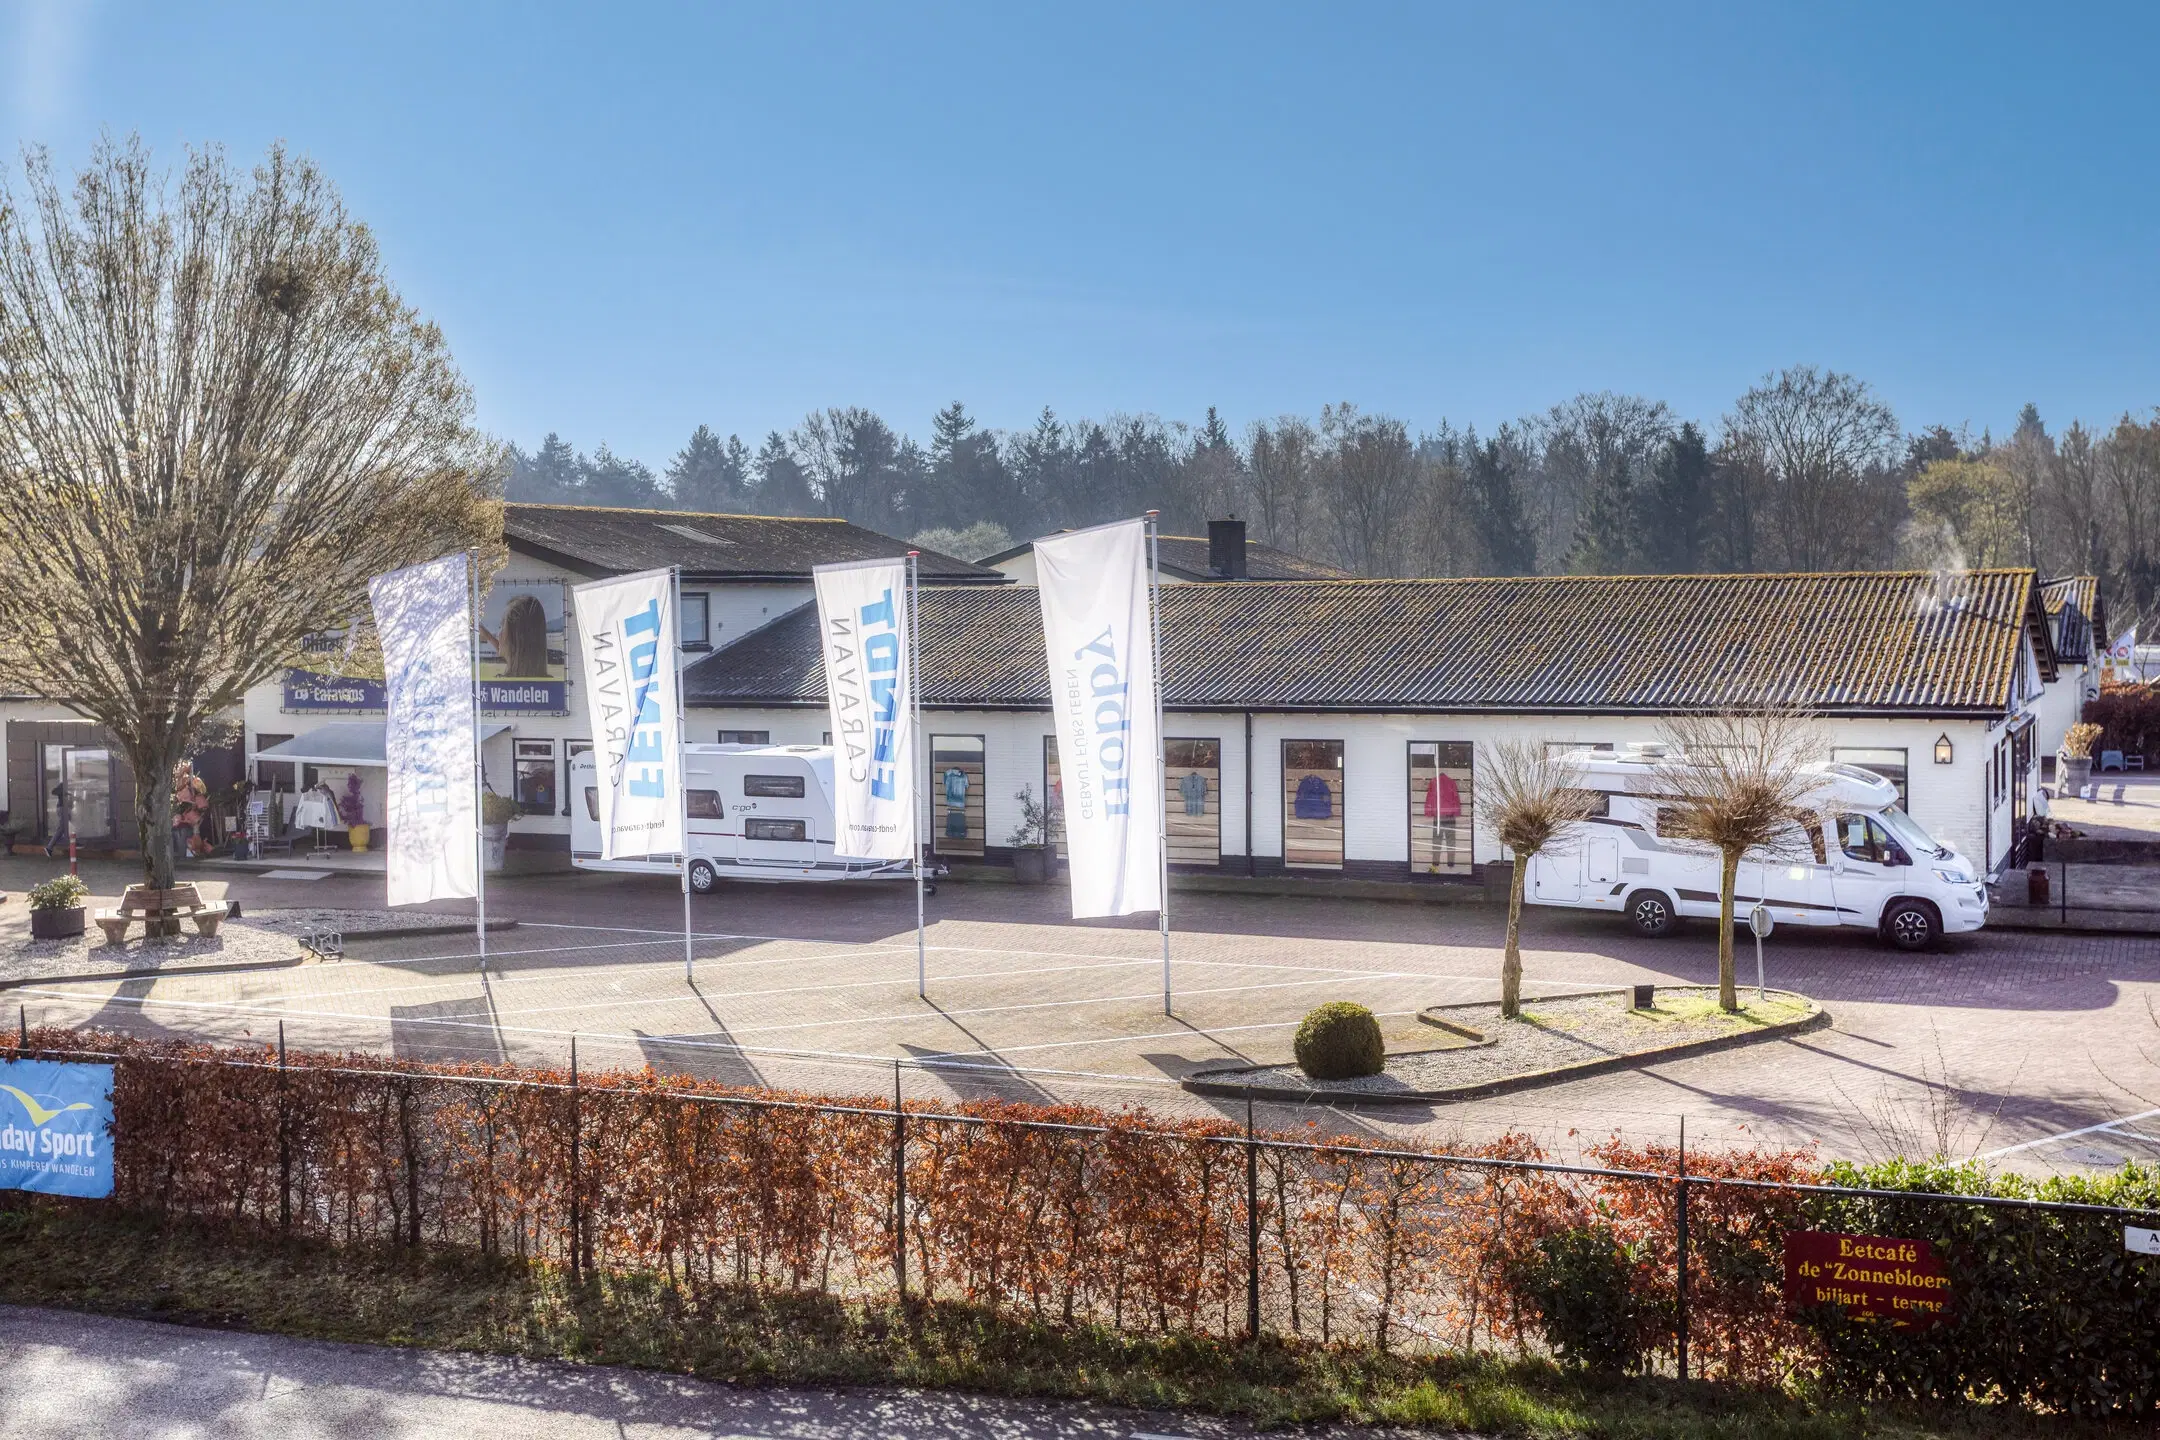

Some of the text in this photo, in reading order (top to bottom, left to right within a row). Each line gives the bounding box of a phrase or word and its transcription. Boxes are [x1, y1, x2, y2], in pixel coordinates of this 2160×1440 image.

[490, 686, 549, 703] Wandelen
[0, 1123, 95, 1160] day Sport
[51, 1163, 95, 1177] WANDELEN
[1839, 1238, 1918, 1263] Eetcafé
[1798, 1260, 1821, 1278] de
[1816, 1287, 1869, 1306] biljart
[1893, 1294, 1943, 1313] terras
